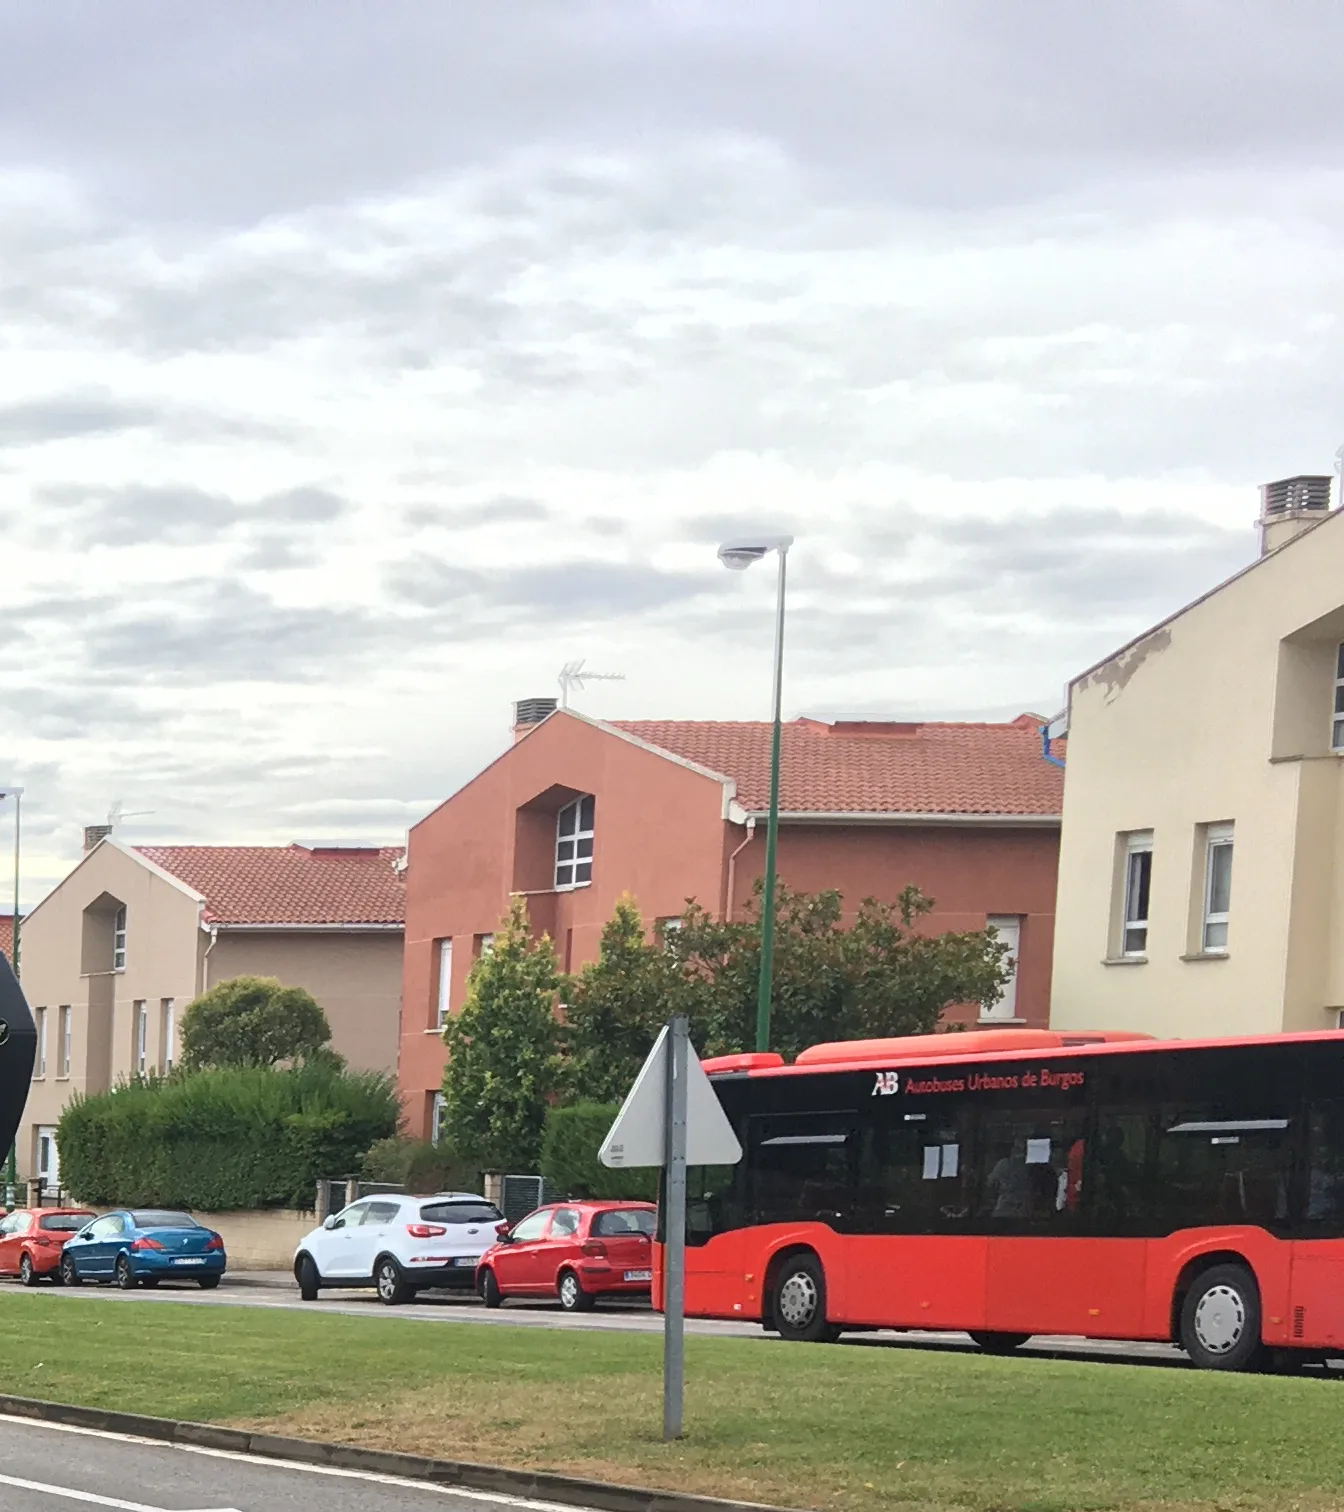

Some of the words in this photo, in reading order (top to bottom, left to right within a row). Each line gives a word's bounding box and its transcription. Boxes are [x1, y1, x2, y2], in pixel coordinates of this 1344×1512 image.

[871, 1071, 899, 1096] AB
[904, 1076, 965, 1094] Autobuses
[967, 1073, 1019, 1091] Urbanos
[1021, 1070, 1038, 1087] de
[1040, 1068, 1084, 1090] Burgos
